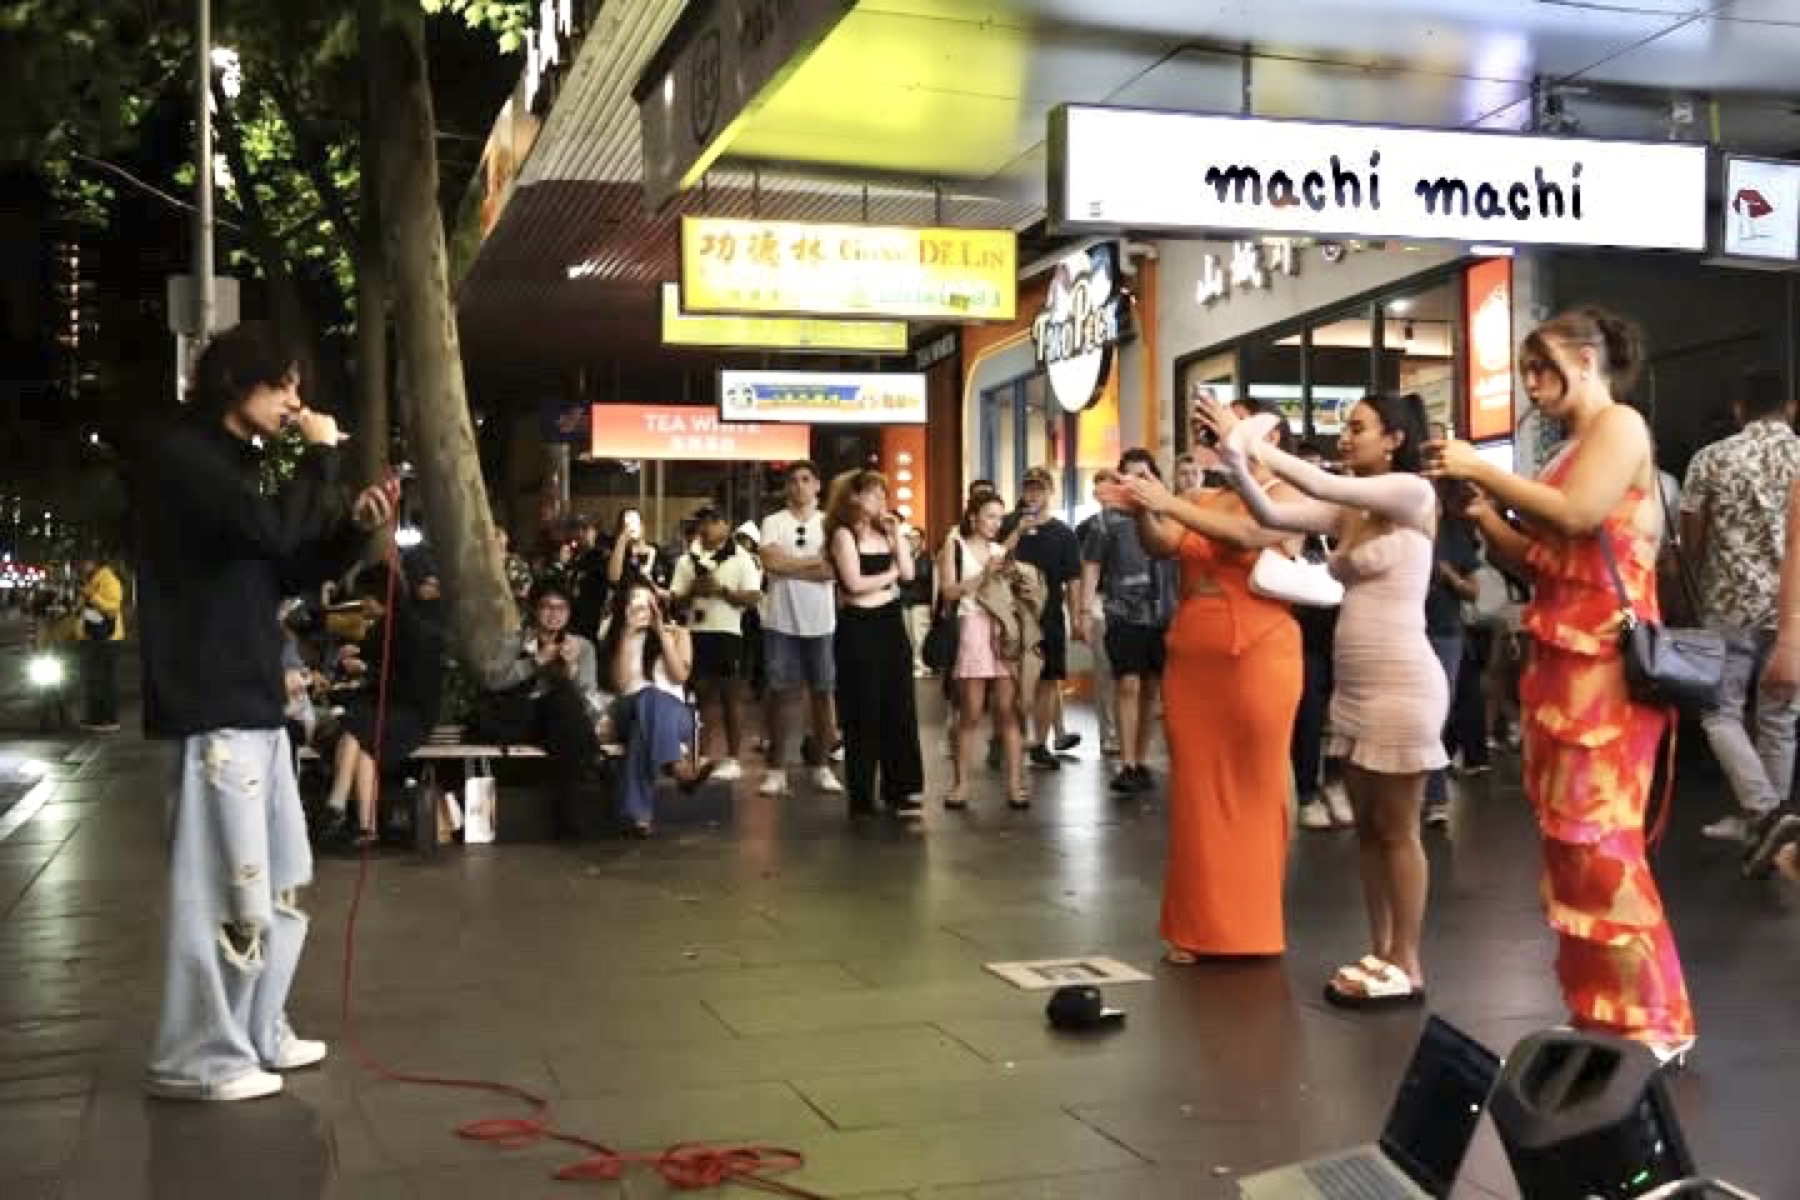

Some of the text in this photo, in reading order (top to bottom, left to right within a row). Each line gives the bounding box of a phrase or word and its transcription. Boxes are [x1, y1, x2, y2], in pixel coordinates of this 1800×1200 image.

[1205, 150, 1582, 220] machi machi
[699, 230, 827, 268] 功德林
[644, 412, 686, 432] TEA
